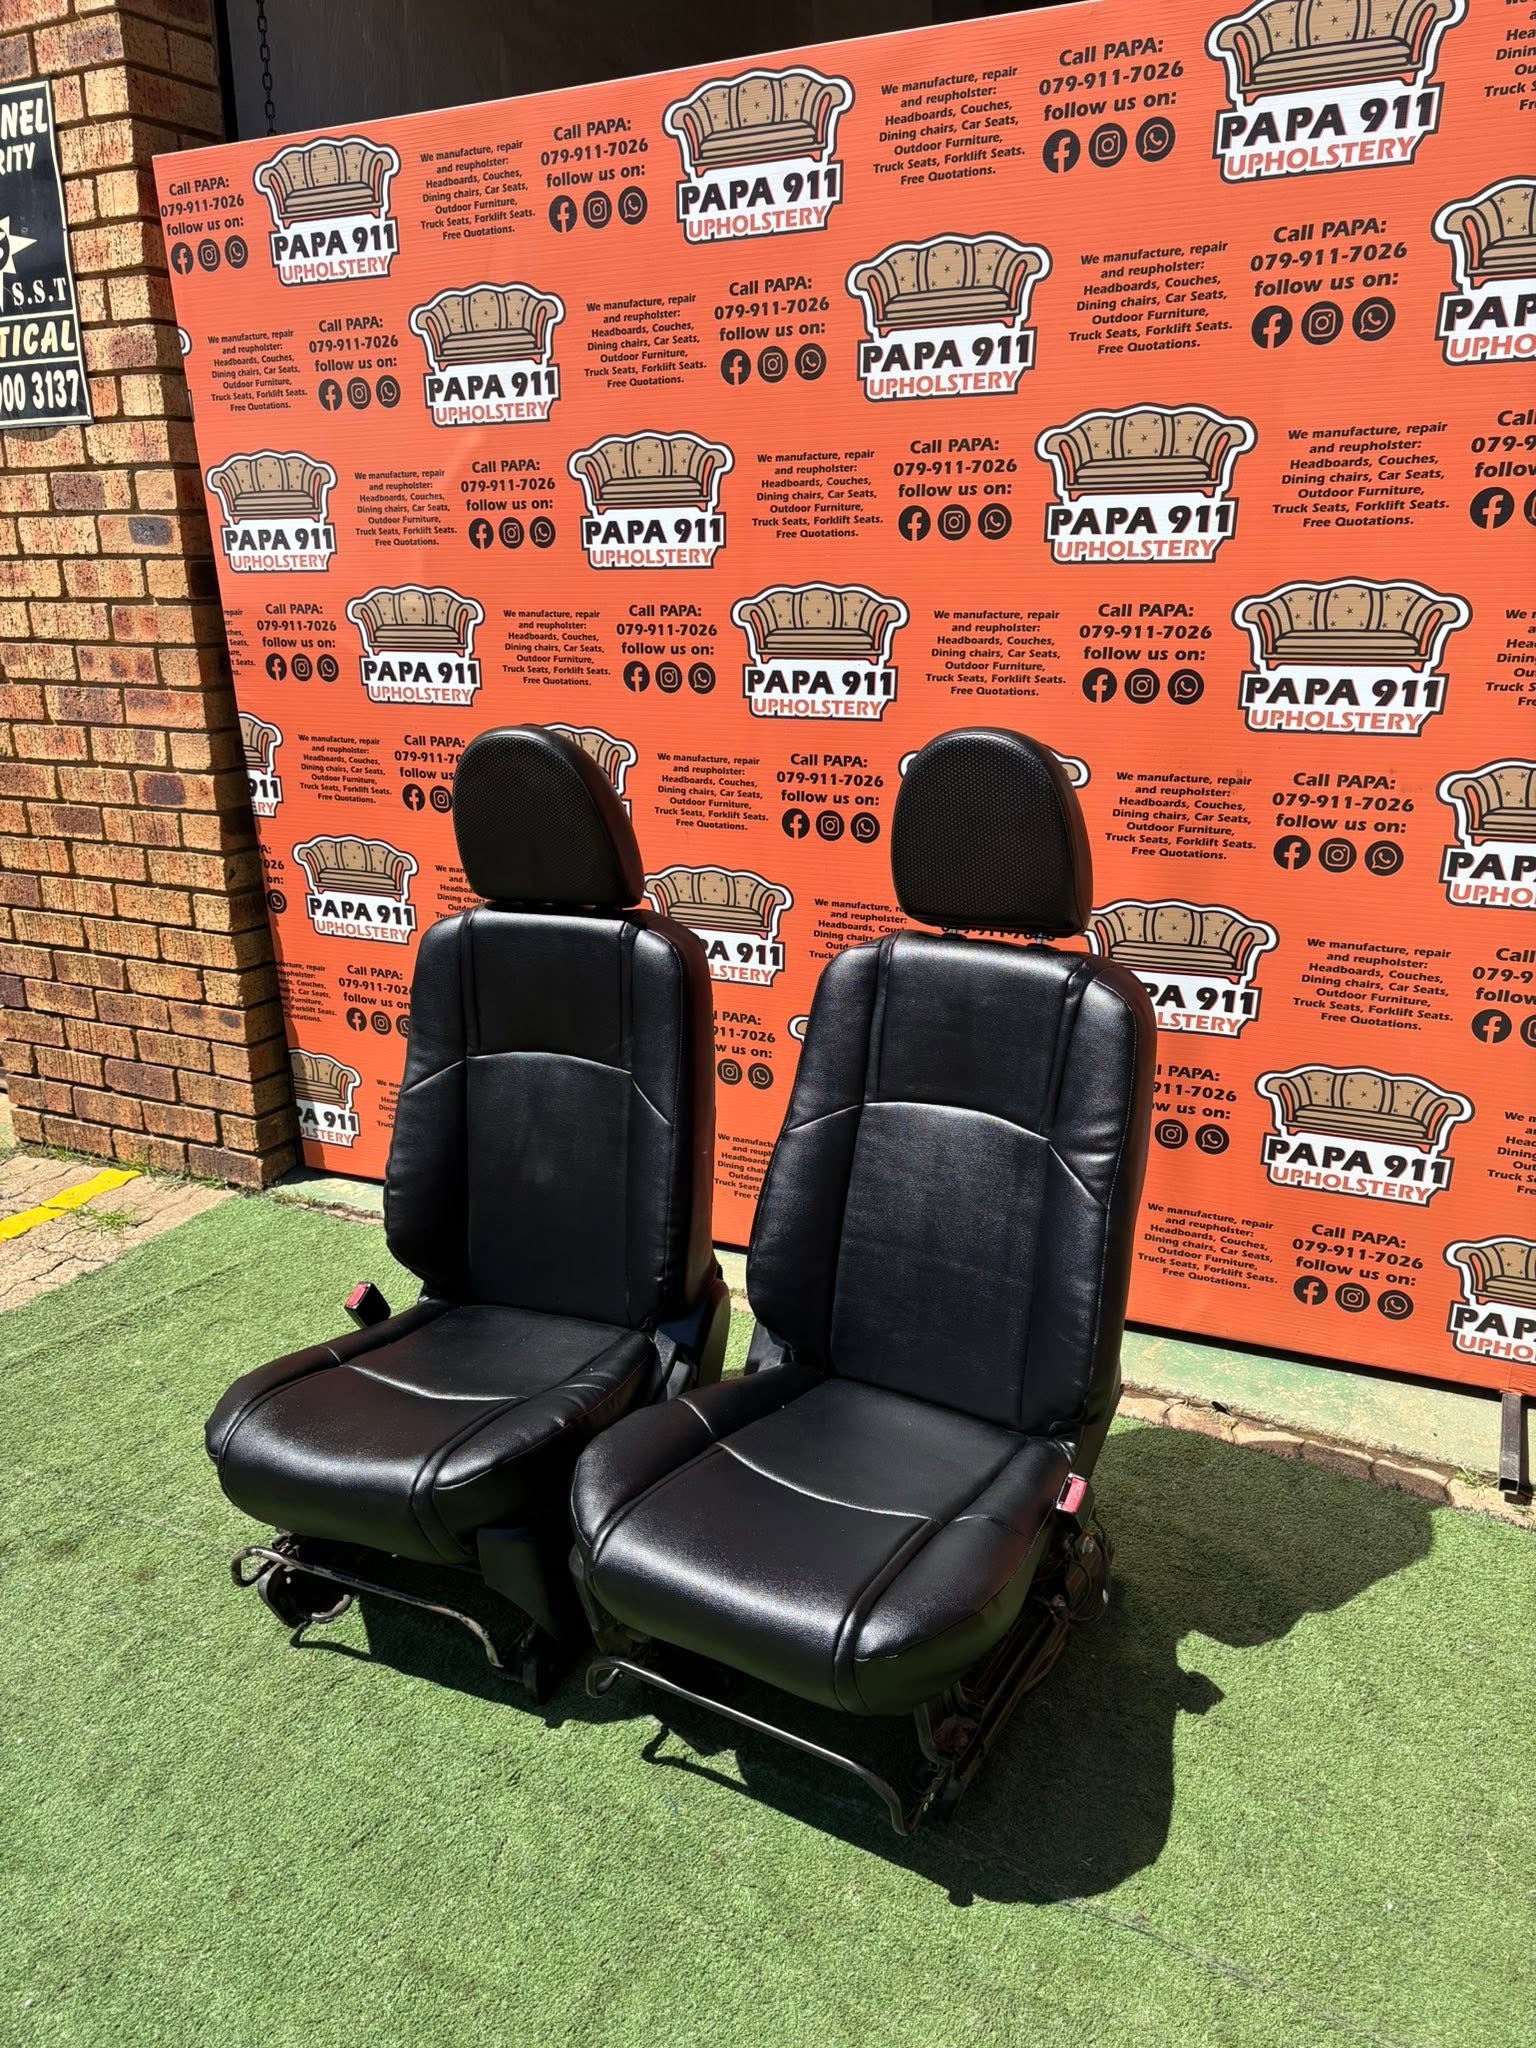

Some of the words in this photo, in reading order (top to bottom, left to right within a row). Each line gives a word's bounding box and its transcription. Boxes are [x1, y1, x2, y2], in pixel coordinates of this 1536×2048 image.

[1059, 46, 1096, 66] Call
[1103, 37, 1163, 60] PAPA:
[1038, 61, 1183, 96] 079-911-7026
[1043, 101, 1106, 121] follow
[1113, 97, 1135, 112] us
[1143, 92, 1176, 107] on:
[1, 98, 48, 140] NEL
[1220, 104, 1346, 150] PAPA
[1359, 91, 1434, 133] 911
[1227, 136, 1414, 176] UPHOLSTERY
[169, 181, 191, 196] Call
[194, 176, 229, 192] PAPA:
[681, 176, 775, 214] PAPA
[783, 167, 836, 201] 911
[160, 194, 244, 217] 079-911-7026
[166, 222, 203, 236] follow
[207, 220, 220, 230] us
[224, 217, 243, 228] on:
[689, 204, 826, 236] UPHOLSTERY
[273, 229, 347, 261] PAPA
[351, 222, 394, 251] 911
[1273, 225, 1314, 243] Call
[1321, 219, 1386, 239] PAPA:
[282, 254, 387, 280] UPHOLSTERY
[1250, 243, 1406, 271] 079-911-7026
[729, 281, 758, 296] Call
[764, 276, 811, 293] PAPA:
[1254, 278, 1322, 296] follow
[1330, 277, 1354, 290] us
[1362, 273, 1397, 288] on:
[586, 303, 600, 312] We
[603, 298, 664, 310] manufacture,
[668, 293, 696, 305] repair
[714, 297, 829, 320] 079-911-7026
[603, 314, 620, 324] and
[623, 310, 680, 322] reupholster:
[591, 325, 649, 338] Headboards,
[652, 322, 694, 332] Couches,
[719, 326, 769, 341] follow
[775, 325, 793, 337] us
[799, 323, 825, 335] on:
[587, 342, 617, 351] Dining
[620, 338, 650, 348] chairs,
[654, 337, 669, 345] Car
[672, 335, 700, 343] Seats,
[863, 339, 962, 373] PAPA
[972, 334, 1030, 365] 911
[600, 353, 638, 363] Outdoor
[641, 349, 688, 359] Furniture,
[583, 368, 609, 377] Truck
[611, 367, 637, 375] Seats,
[641, 362, 676, 372] Forklift
[679, 360, 706, 370] Seats.
[0, 372, 26, 412] 00
[31, 369, 79, 409] 3137
[427, 373, 505, 402] PAPA
[511, 369, 555, 396] 911
[606, 380, 626, 388] Free
[629, 376, 684, 387] Quotations.
[870, 370, 1017, 395] UPHOLSTERY
[435, 400, 548, 421] UPHOLSTERY
[1288, 430, 1308, 439] We
[1312, 426, 1400, 438] manufacture,
[1406, 421, 1447, 436] repair
[1309, 443, 1335, 453] and
[1339, 440, 1421, 453] reupholster:
[1290, 456, 1372, 469] Headboards,
[1378, 454, 1438, 465] Couches,
[1282, 474, 1325, 485] Dining
[1330, 472, 1372, 482] chairs,
[1378, 471, 1400, 480] Car
[1405, 470, 1444, 479] Seats,
[1298, 488, 1353, 498] Outdoor
[1358, 486, 1424, 496] Furniture,
[1273, 504, 1307, 513] Truck
[1312, 503, 1349, 512] Seats,
[1355, 500, 1405, 511] Forklift
[1409, 500, 1449, 509] Seats.
[1050, 506, 1157, 535] PAPA
[1168, 505, 1230, 533] 911
[1303, 518, 1330, 527] Free
[1334, 515, 1413, 526] Quotations.
[224, 528, 290, 551] PAPA
[294, 527, 332, 549] 911
[585, 519, 667, 544] PAPA
[674, 518, 721, 543] 911
[592, 548, 712, 564] UPHOLSTERY
[1057, 539, 1215, 558] UPHOLSTERY
[232, 554, 327, 568] UPHOLSTERY
[363, 660, 433, 682] PAPA
[437, 662, 477, 683] 911
[747, 668, 834, 693] PAPA
[842, 670, 892, 695] 911
[371, 686, 471, 701] UPHOLSTERY
[1245, 676, 1359, 705] PAPA
[1372, 679, 1439, 707] 911
[754, 697, 882, 714] UPHOLSTERY
[1251, 710, 1421, 730] UPHOLSTERY
[790, 753, 818, 765] Call
[823, 754, 867, 768] PAPA:
[776, 771, 883, 787] 079-911-7026
[781, 789, 827, 803] follow
[833, 794, 849, 804] us
[855, 796, 879, 806] on:
[309, 897, 372, 921] PAPA
[376, 904, 412, 925] 911
[316, 920, 407, 940] UPHOLSTERY
[736, 942, 780, 966] 911
[1307, 939, 1325, 947] We
[1329, 942, 1409, 955] manufacture,
[1414, 948, 1451, 958] repair
[1326, 954, 1349, 962] and
[1353, 956, 1428, 968] reupholster:
[347, 964, 367, 975] Call
[370, 967, 403, 980] PAPA:
[1308, 963, 1383, 978] Headboards,
[1388, 970, 1443, 983] Couches,
[338, 977, 411, 995] 079-911-702
[1301, 975, 1340, 987] Dining
[1344, 979, 1383, 991] chairs,
[1388, 983, 1409, 991] Car
[1413, 985, 1448, 996] Seats,
[343, 992, 377, 1005] follow
[380, 999, 393, 1007] us
[1196, 987, 1253, 1015] 911
[1315, 988, 1366, 1000] Outdoor
[1370, 993, 1430, 1007] Furniture,
[1292, 998, 1324, 1008] Truck
[1328, 1001, 1362, 1013] Seats,
[1368, 1005, 1413, 1017] Forklift
[1417, 1010, 1453, 1020] Seats.
[1320, 1012, 1345, 1022] Free
[1349, 1016, 1421, 1029] Quotations.
[323, 1111, 357, 1132] 911
[1267, 1138, 1372, 1174] PAPA
[1383, 1154, 1445, 1184] 911
[1273, 1167, 1428, 1200] UPHOLSTERY
[1312, 1224, 1346, 1239] Call
[1352, 1230, 1405, 1249] PAPA:
[1292, 1238, 1422, 1269] 079-911-7026
[1296, 1256, 1353, 1275] follow
[1359, 1269, 1379, 1280] us
[1385, 1274, 1415, 1286] on:
